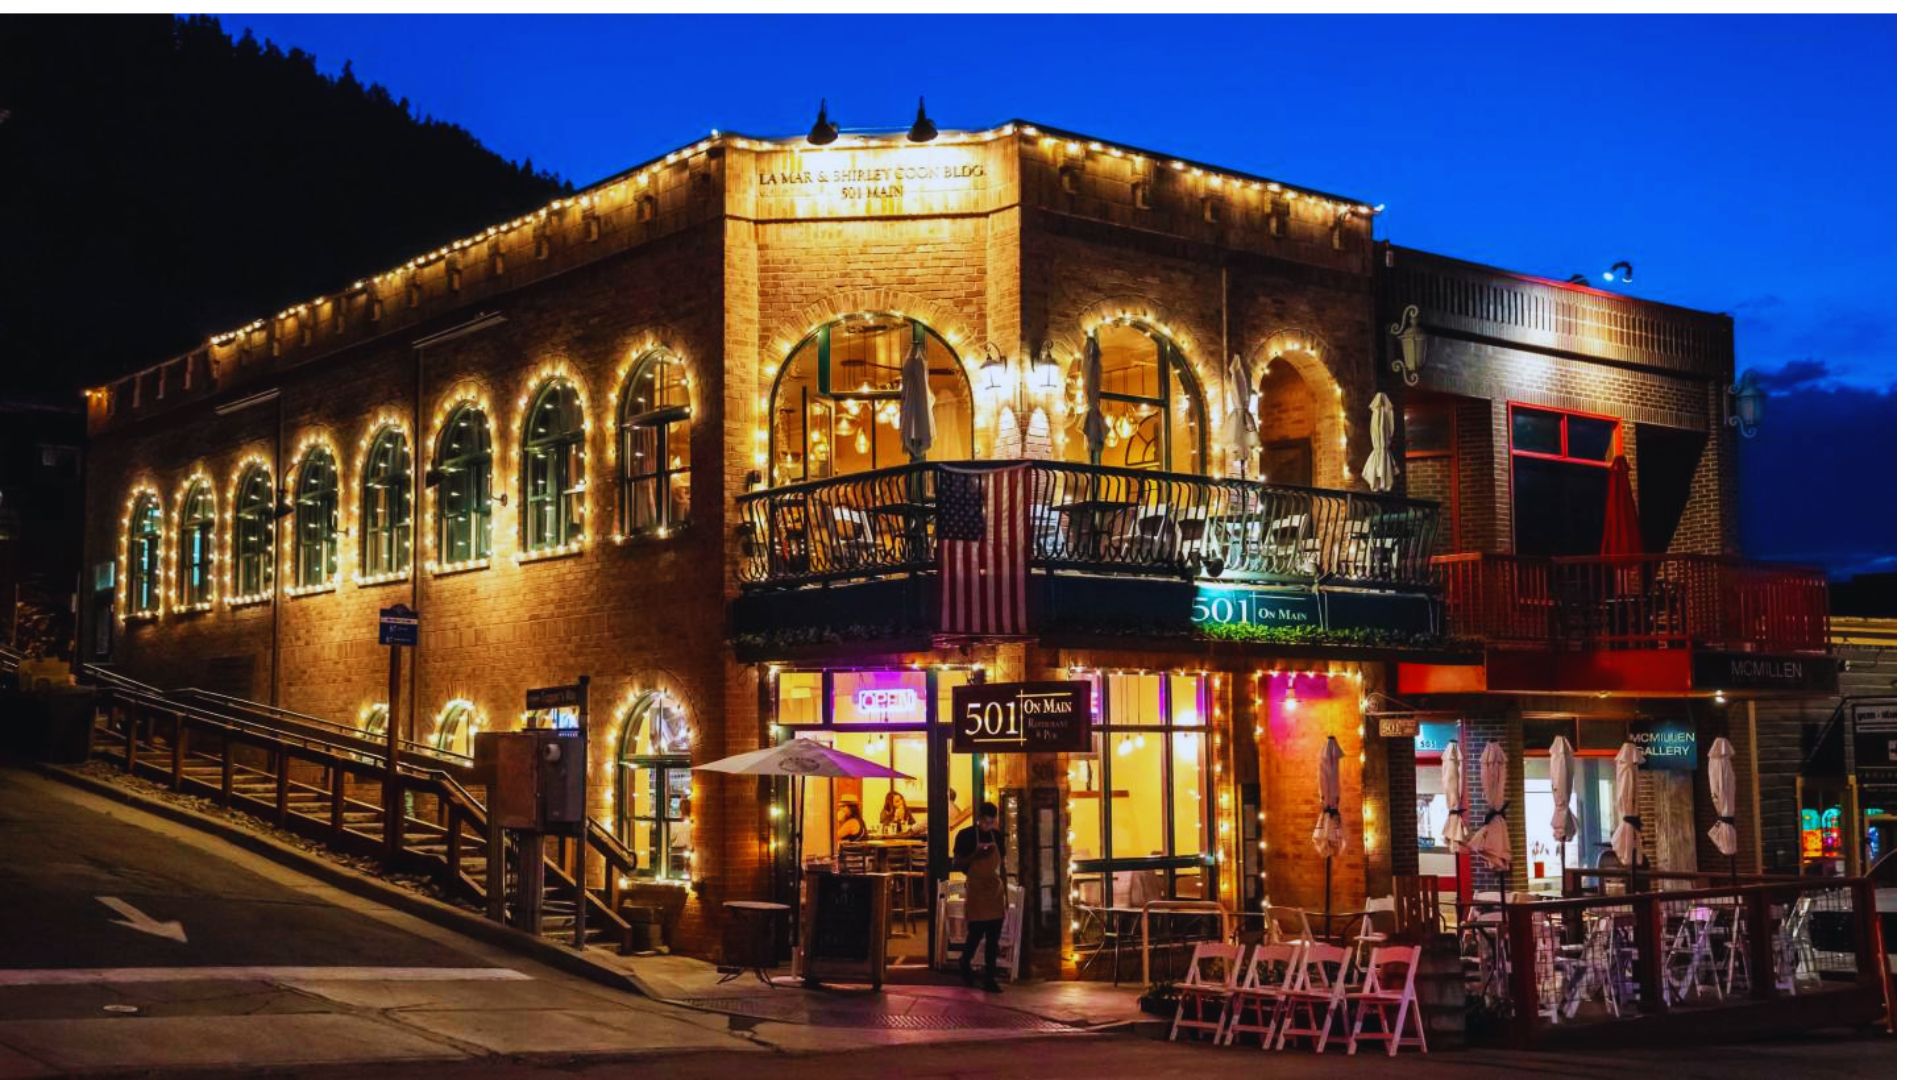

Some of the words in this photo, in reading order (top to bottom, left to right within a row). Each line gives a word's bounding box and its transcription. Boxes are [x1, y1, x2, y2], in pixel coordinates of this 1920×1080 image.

[780, 171, 812, 184] MAR
[817, 170, 828, 182] &
[833, 168, 891, 183] SHIRLEY
[841, 186, 862, 200] 501
[866, 184, 904, 199] MAIN
[1190, 597, 1247, 623] 501
[1731, 660, 1802, 678] MCMILLEN
[861, 690, 913, 710] OPEN
[964, 701, 1019, 735] 501
[1629, 732, 1695, 743] MCMILLEN
